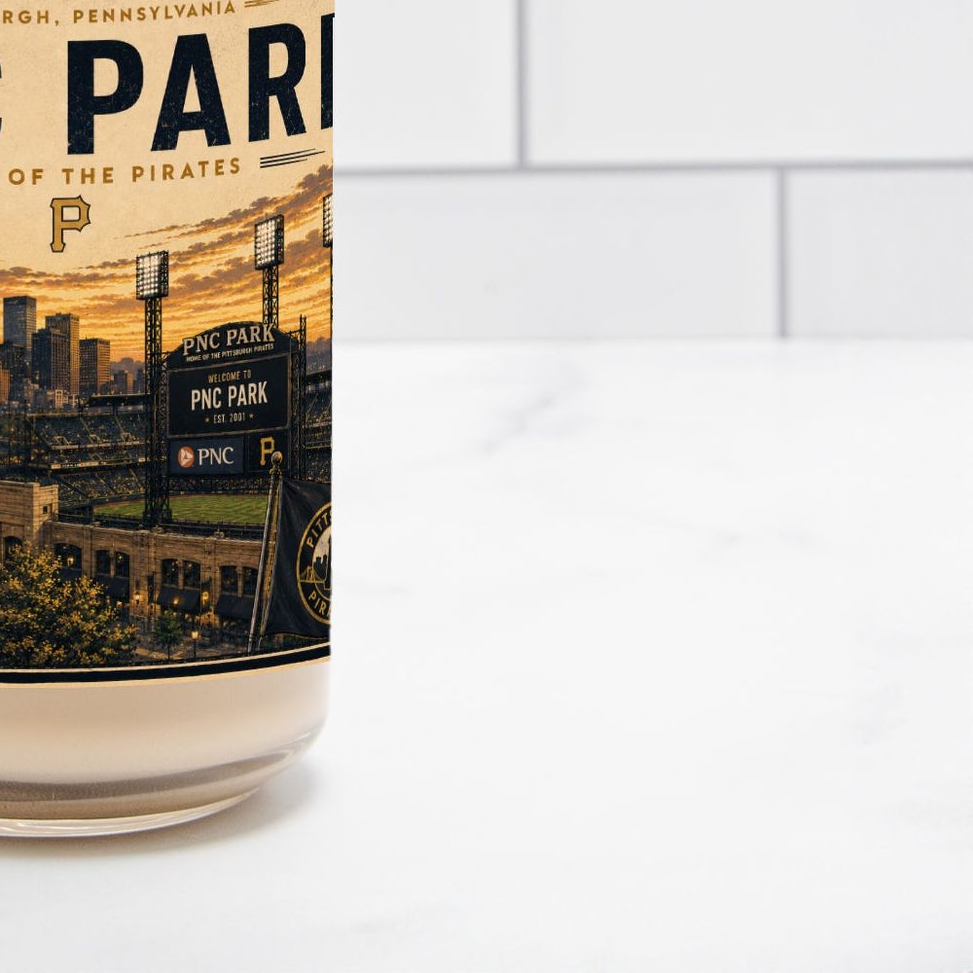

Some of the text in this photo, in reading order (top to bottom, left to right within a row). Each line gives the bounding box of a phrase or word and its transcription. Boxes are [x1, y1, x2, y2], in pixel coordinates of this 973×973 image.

[73, 1, 236, 23] PENNSYLVANIA
[8, 166, 45, 186] OF
[62, 166, 114, 185] THE
[132, 157, 241, 183] PIRATES
[49, 194, 92, 253] P
[183, 323, 276, 356] PNC PARK
[186, 354, 201, 363] HOME
[202, 353, 210, 361] OF
[211, 352, 221, 360] THE
[207, 370, 252, 384] WELCOME TO
[191, 381, 268, 411] PNC PARK
[229, 412, 246, 423] 2001
[197, 446, 234, 466] PNC
[259, 436, 276, 466] P
[306, 509, 332, 548] PITT
